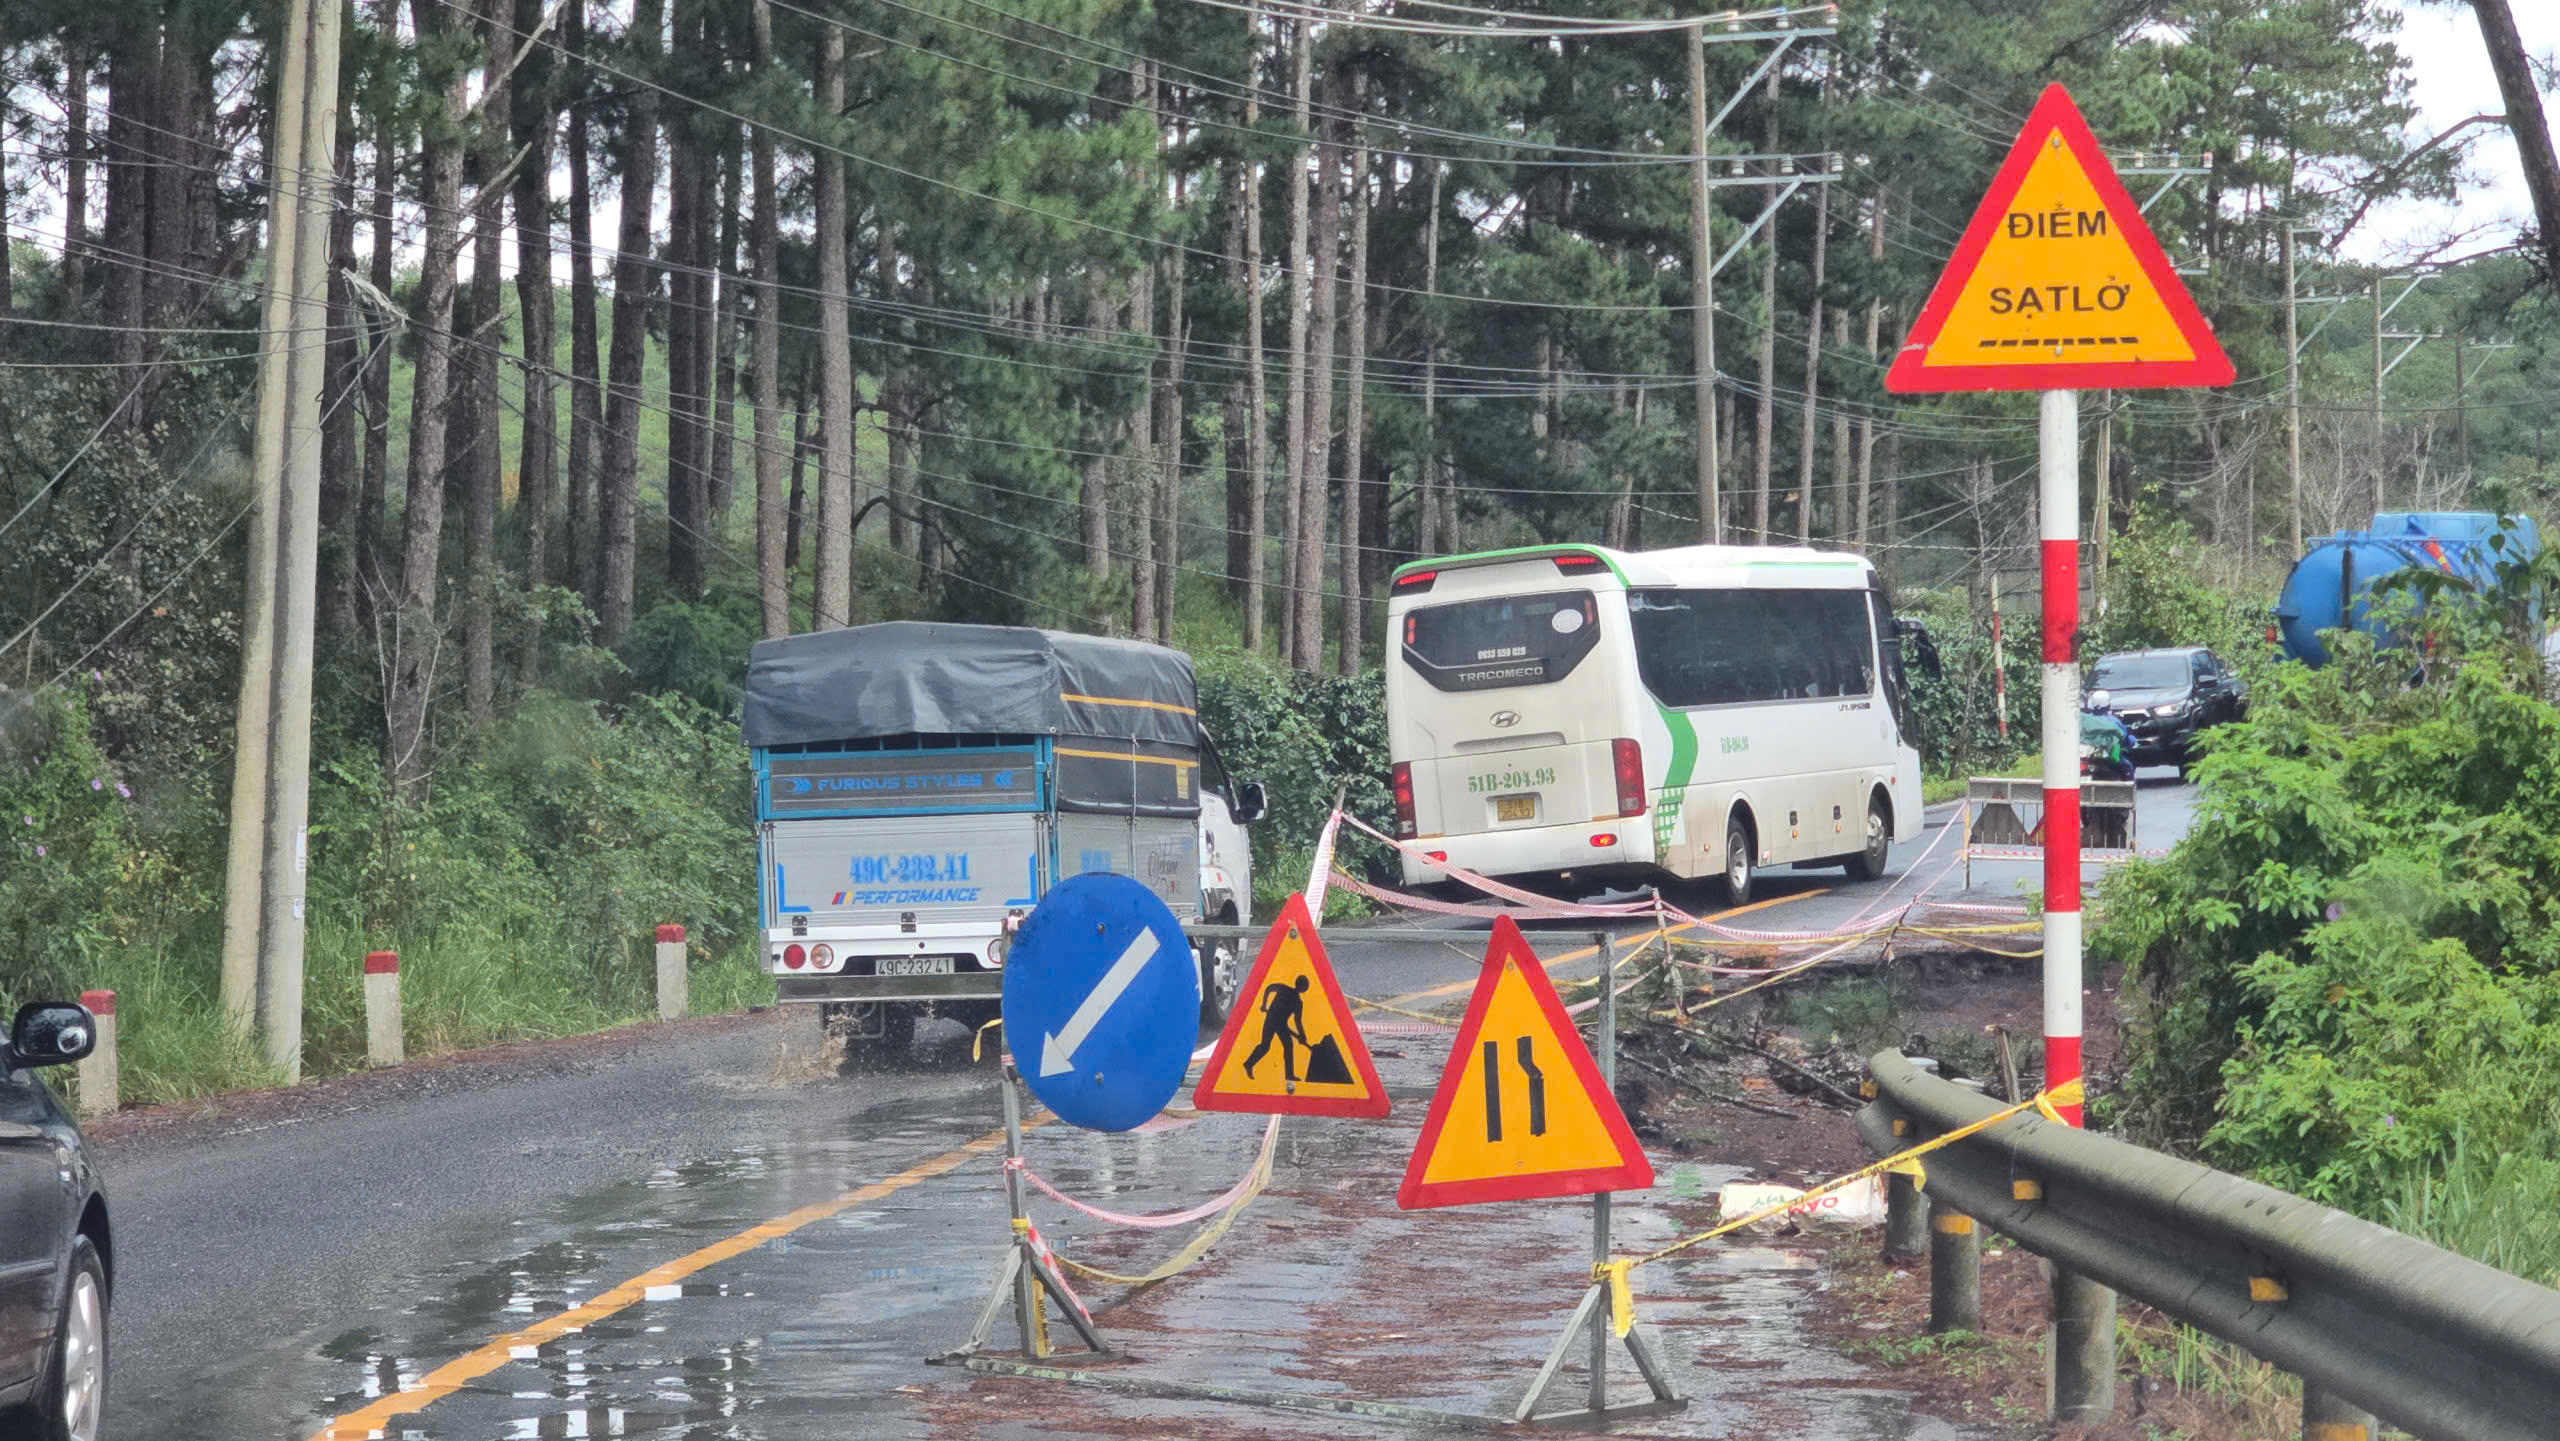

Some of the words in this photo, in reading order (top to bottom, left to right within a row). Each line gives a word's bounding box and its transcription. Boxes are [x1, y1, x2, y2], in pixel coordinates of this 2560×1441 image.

[1458, 666, 1544, 682] TRACOMECO
[818, 775, 901, 792] FURIOUS
[904, 773, 983, 789] STYLES
[1468, 767, 1556, 793] 51B-204.93
[849, 852, 971, 885] 49C-232.41
[852, 887, 982, 905] PERFORMANCE
